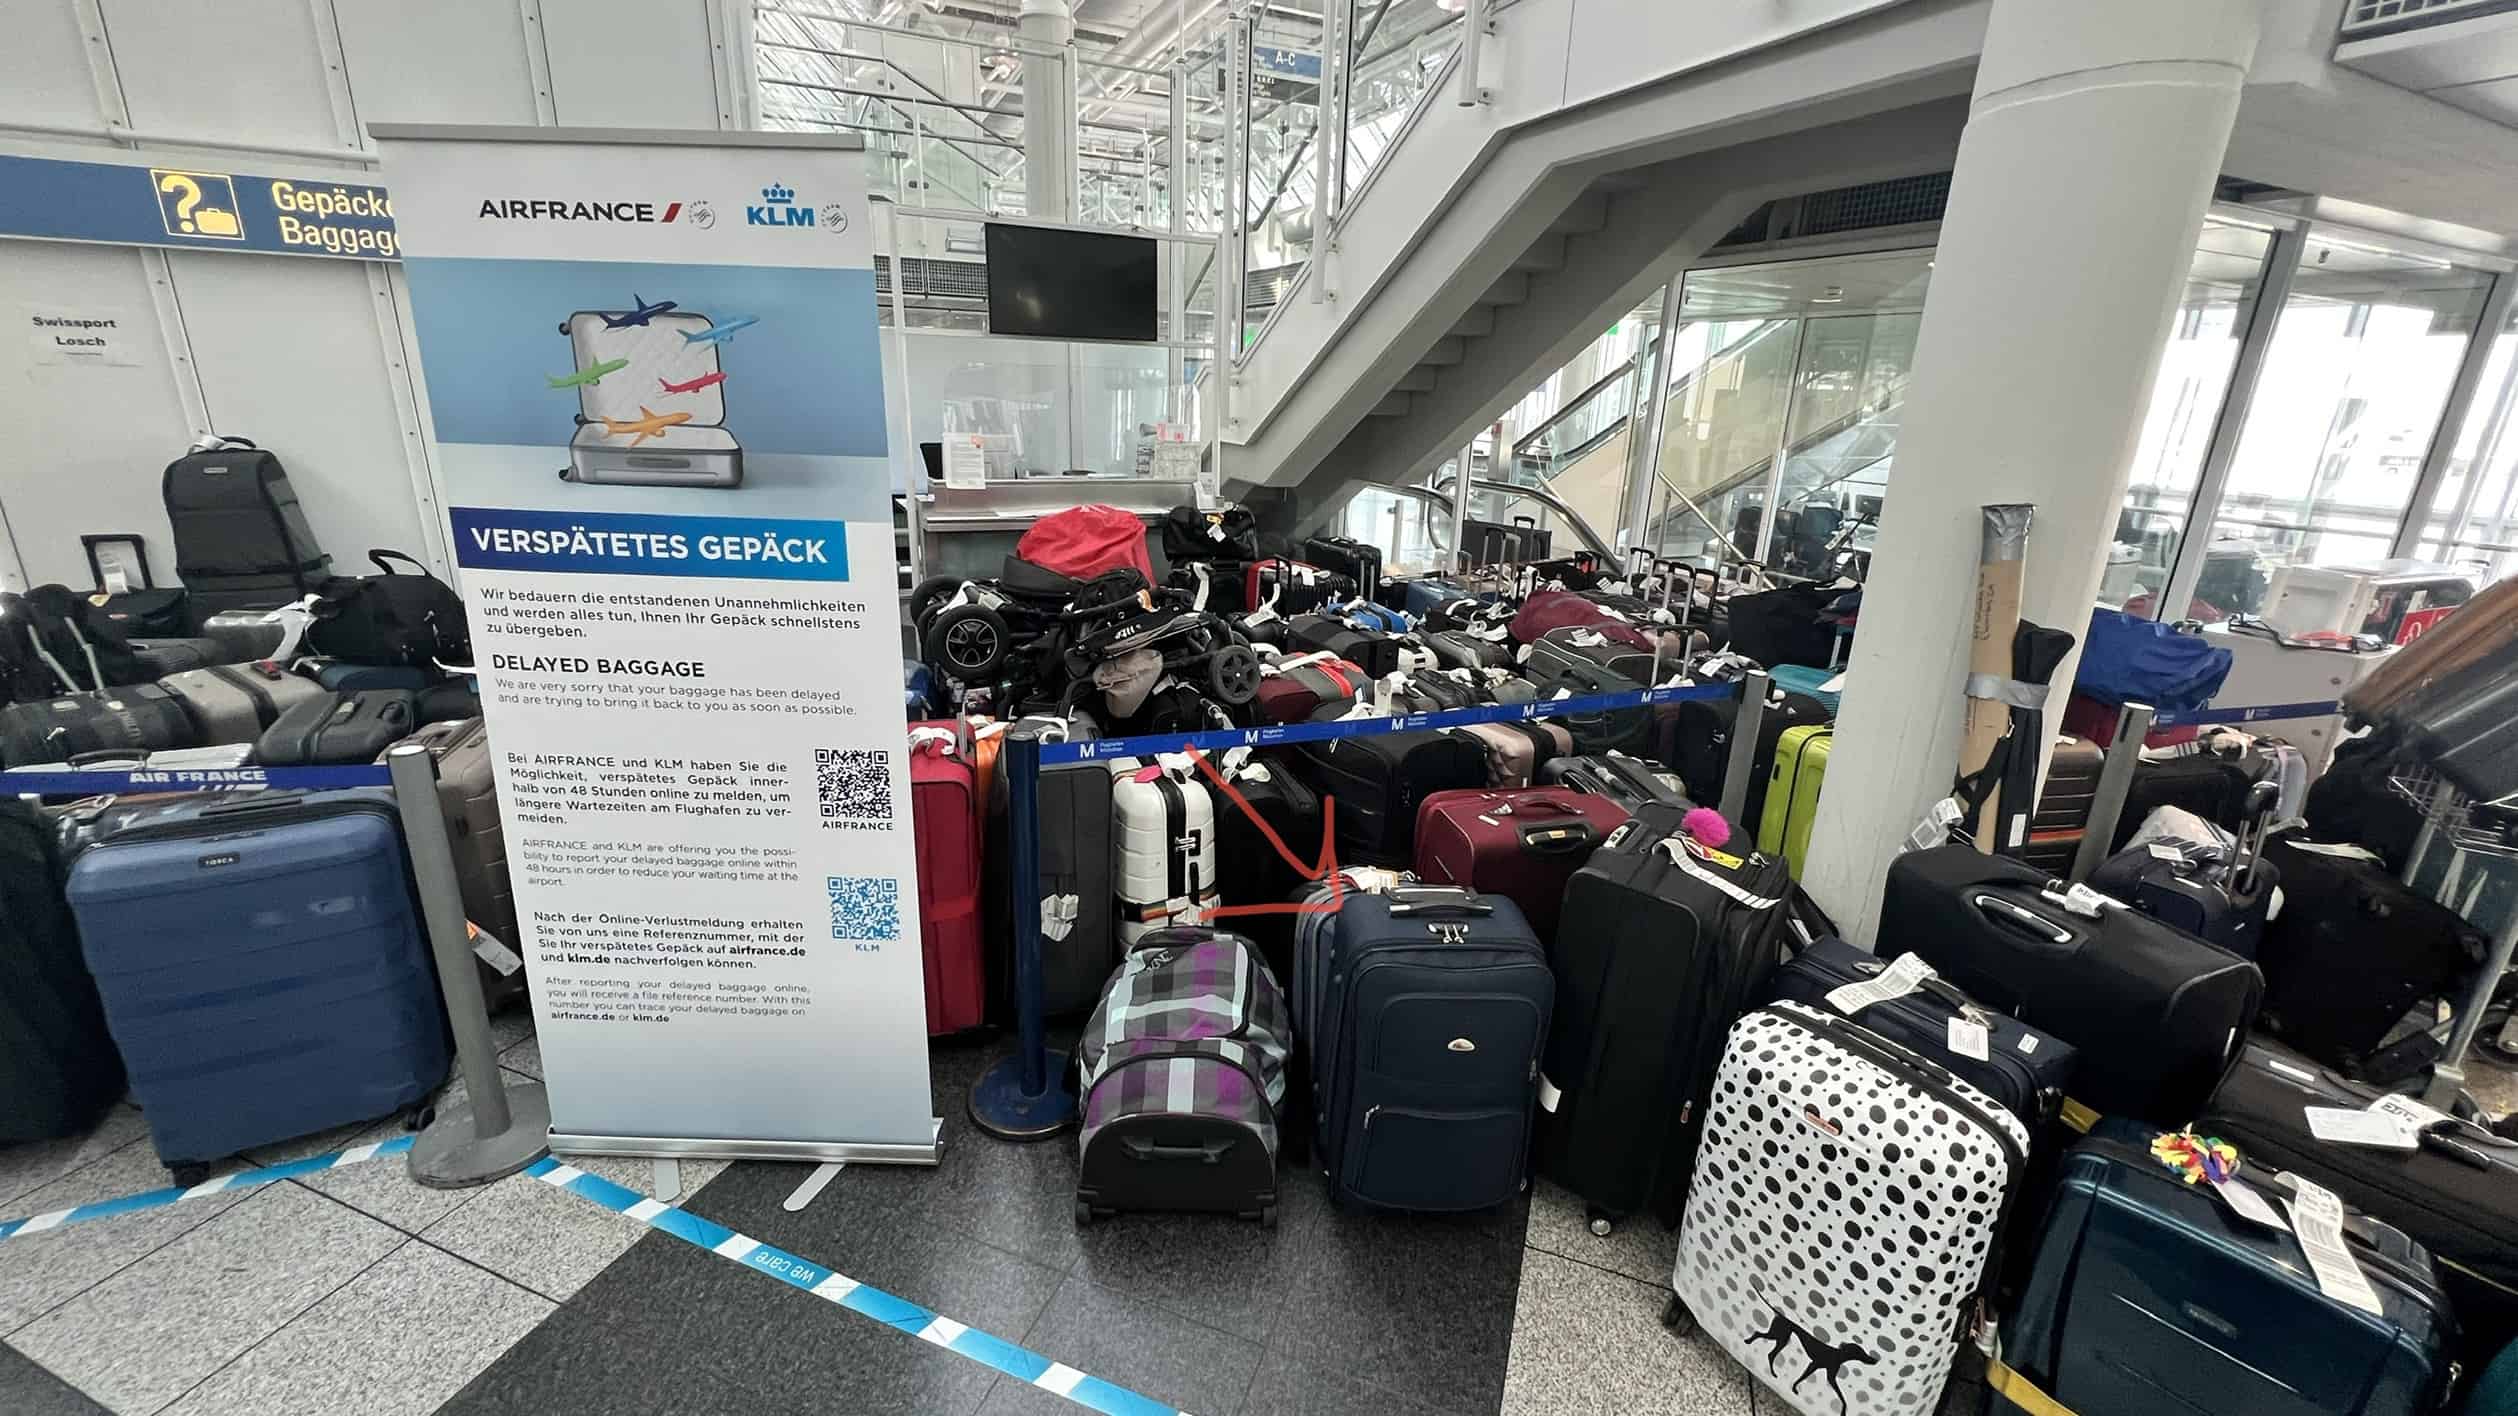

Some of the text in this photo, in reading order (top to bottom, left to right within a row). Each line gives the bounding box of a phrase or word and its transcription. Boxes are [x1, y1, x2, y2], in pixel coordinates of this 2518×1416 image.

[1275, 50, 1296, 66] A-C
[479, 199, 655, 222] AIRFRANCE
[746, 206, 815, 227] KLM
[32, 316, 117, 329] Swissport
[56, 336, 106, 346] Losch
[470, 526, 827, 564] VERSPÄTETES GEPÄCK
[480, 588, 865, 612] Wir bedauern die entstandenen Unannehmlichkeiten
[483, 605, 861, 629] und werden alles tun, Ihnen Ihr Gepäck schnellstens
[486, 622, 587, 638] zu übergeben.
[492, 654, 705, 677] DELAYED BAGGAGE
[495, 678, 840, 702] We are very sorry that your baggage has been delayed
[1640, 690, 1652, 703] M
[498, 694, 519, 703] and
[522, 696, 542, 704] are
[542, 695, 583, 708] trying
[586, 697, 601, 707] to
[603, 697, 638, 709] bring
[641, 699, 650, 708] it
[653, 698, 684, 710] back
[687, 700, 701, 710] to
[704, 702, 728, 712] you
[732, 703, 747, 711] as
[749, 703, 781, 712] soon
[784, 704, 799, 713] as
[1522, 704, 1535, 717] M
[1391, 718, 1404, 730] M
[1244, 730, 1258, 744] M
[1080, 743, 1094, 758] M
[507, 752, 788, 772] Bei AIRFRANCE und KLM haben Sie die
[130, 770, 267, 783] AIR FRANCE
[510, 767, 789, 787] Möglichkeit, verspätetes Gepäck inner-
[512, 782, 790, 803] halb von 48 Stunden online zu melden, um
[514, 797, 792, 816] längere Wartezeiten am Flughafen zu ver-
[517, 813, 568, 824] meiden.
[822, 820, 893, 831] AIRFRANCE
[522, 838, 588, 850] AIRFRANCE
[592, 842, 614, 850] and
[617, 842, 642, 852] KLM
[646, 844, 664, 852] are
[668, 844, 711, 855] offering
[715, 848, 736, 856] you
[740, 845, 759, 855] the
[551, 853, 564, 861] to
[566, 854, 600, 863] report
[603, 856, 628, 865] your
[631, 855, 674, 866] delayed
[676, 856, 725, 868] baggage
[727, 858, 761, 868] online
[763, 858, 797, 869] within
[525, 863, 540, 872] 48
[541, 864, 572, 874] hours
[584, 865, 616, 876] order
[618, 867, 630, 876] to
[632, 867, 670, 877] reduce
[671, 870, 696, 880] your
[697, 871, 738, 881] waiting
[740, 871, 765, 880] time
[767, 872, 778, 880] at
[780, 872, 800, 881] the
[534, 911, 803, 930] Nach der Online-Verlustmeldung erhalten
[536, 925, 555, 935] Sie
[612, 928, 639, 938] eine
[643, 928, 754, 943] Referenznummer,
[758, 932, 779, 942] mit
[783, 933, 804, 943] der
[538, 938, 806, 956] Sie Ihr verspätetes Gepäck auf airfrance.de
[855, 943, 880, 952] KLM
[541, 952, 756, 968] und klm.de nachverfolgen können.
[579, 979, 630, 988] reporting
[637, 981, 662, 989] your
[669, 980, 712, 991] delayed
[718, 983, 767, 993] baggage
[546, 990, 567, 998] you
[570, 989, 588, 998] will
[591, 991, 630, 999] receive
[642, 990, 659, 1000] file
[662, 992, 712, 1002] reference
[761, 995, 788, 1004] With
[791, 996, 811, 1005] this
[548, 1000, 590, 1009] number
[593, 1003, 613, 1011] you
[638, 1003, 666, 1011] trace
[668, 1005, 693, 1013] your
[695, 1003, 738, 1016] delayed
[740, 1006, 789, 1016] baggage
[791, 1007, 808, 1016] on
[551, 1011, 615, 1021] airfrance.de
[632, 1013, 670, 1022] klm.de
[756, 1252, 815, 1282] we care
